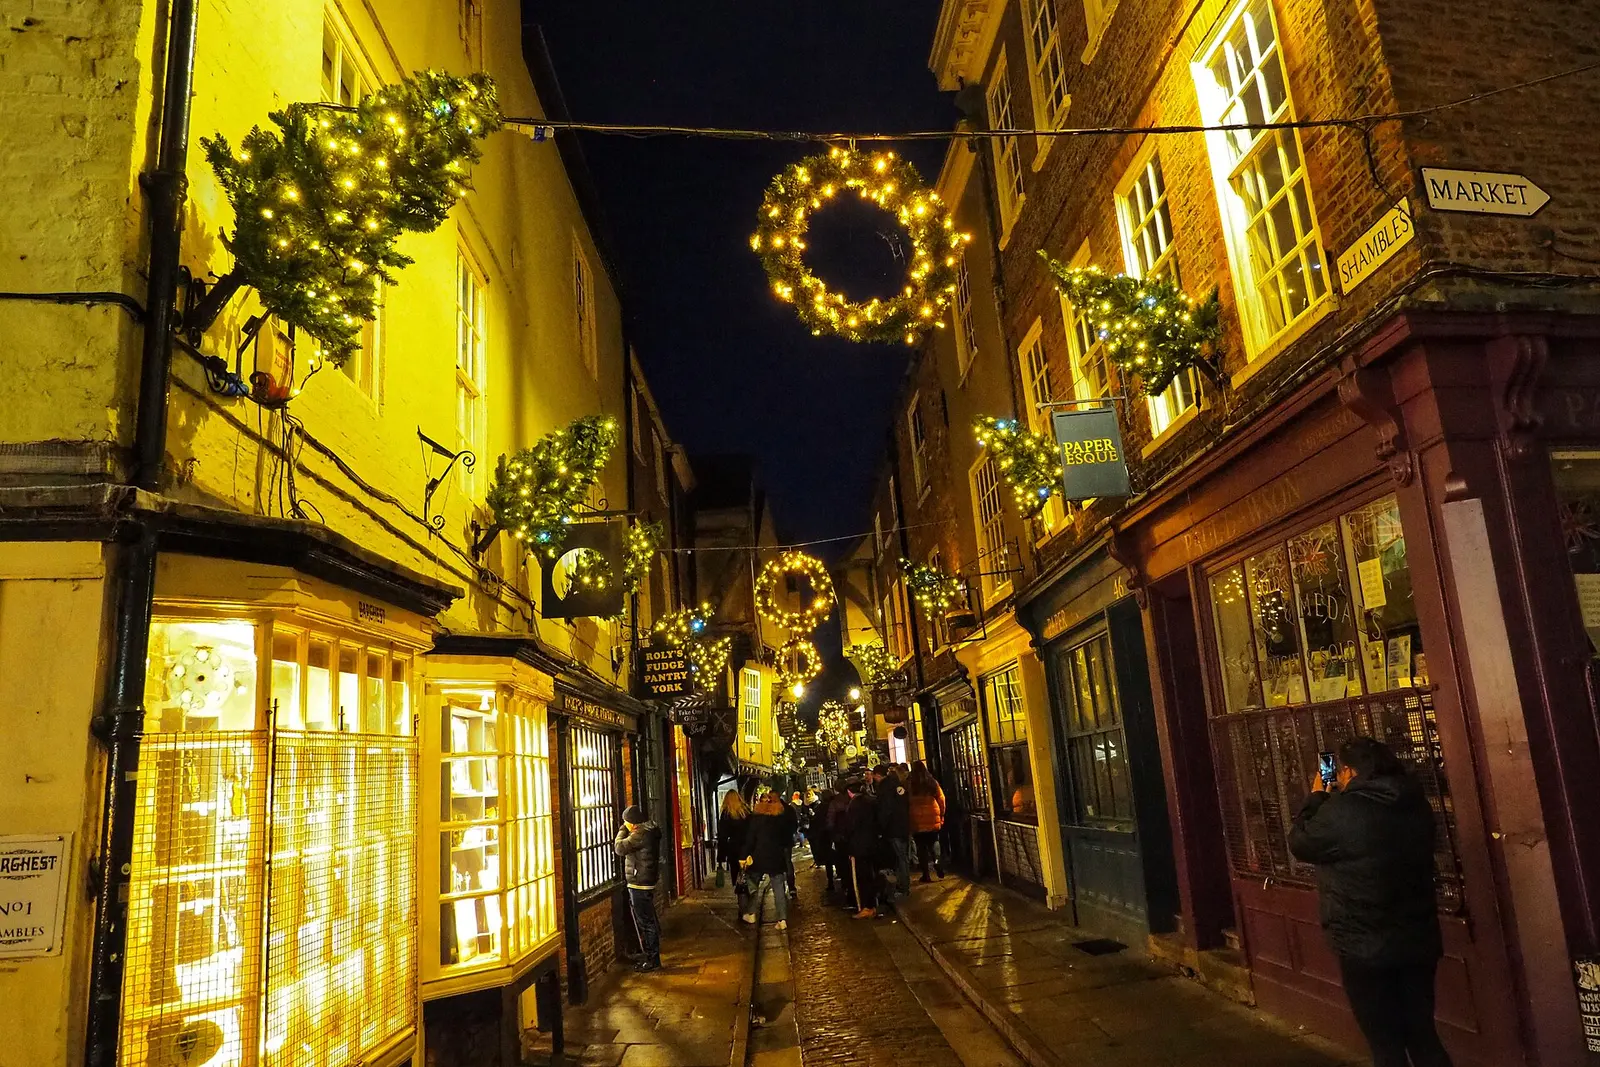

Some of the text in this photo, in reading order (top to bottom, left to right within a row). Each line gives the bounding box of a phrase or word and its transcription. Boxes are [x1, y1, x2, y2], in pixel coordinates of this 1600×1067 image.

[1429, 178, 1528, 206] MARKET
[1341, 211, 1410, 285] SHAMBLES
[1063, 438, 1116, 455] PAPER
[1065, 450, 1119, 465] ESQUE
[1112, 576, 1125, 600] 46
[645, 649, 684, 661] ROLY'S
[646, 660, 685, 672] FUDGE
[644, 671, 688, 683] PANTRY
[651, 683, 683, 693] YORK
[0, 926, 45, 938] MBLES
